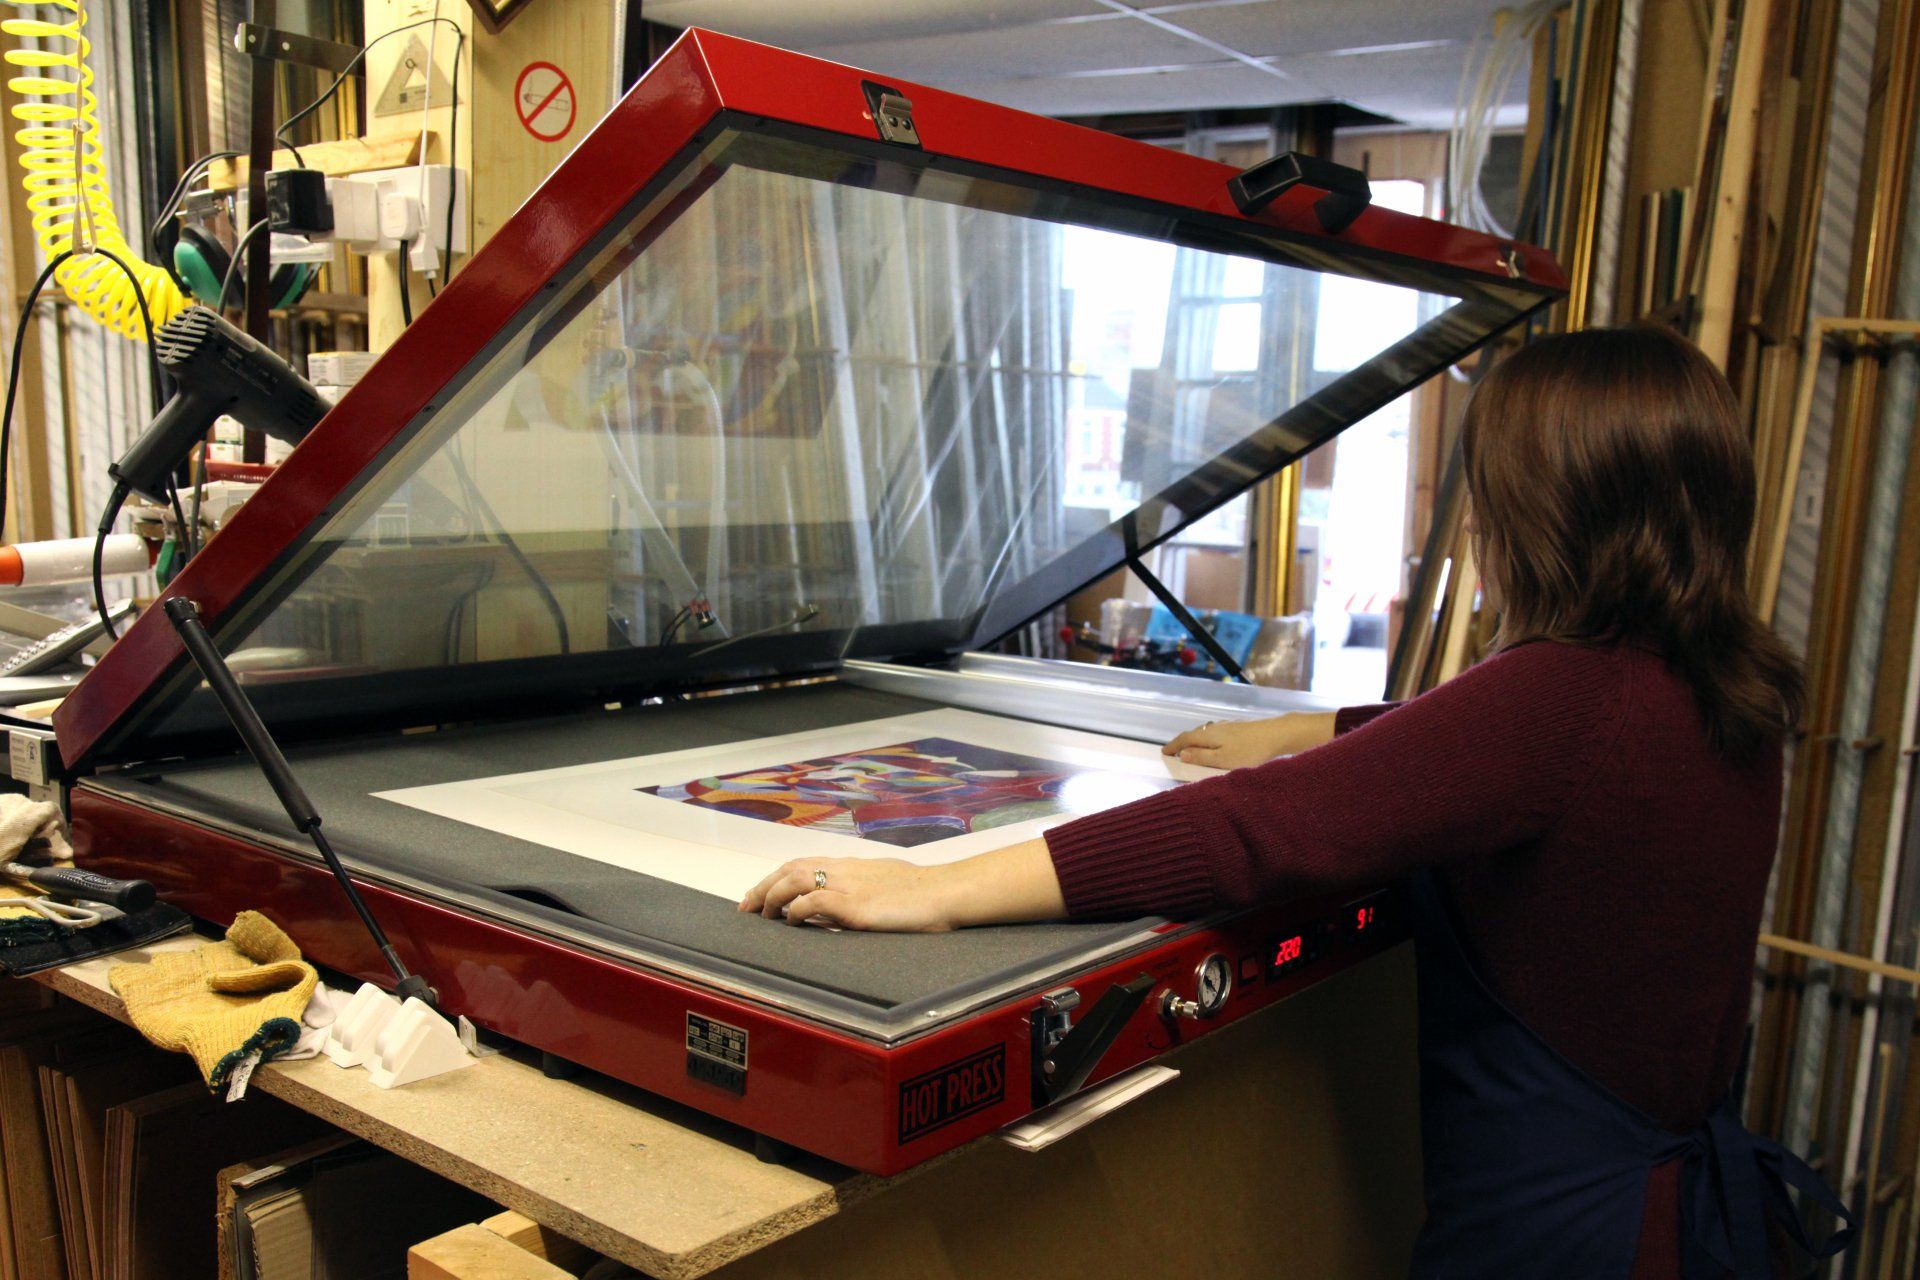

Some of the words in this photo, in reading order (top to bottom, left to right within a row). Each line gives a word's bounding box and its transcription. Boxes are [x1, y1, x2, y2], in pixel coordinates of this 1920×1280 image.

[1356, 906, 1374, 930] 91
[902, 1079, 941, 1132] HOT
[946, 1054, 1002, 1113] PRESS
